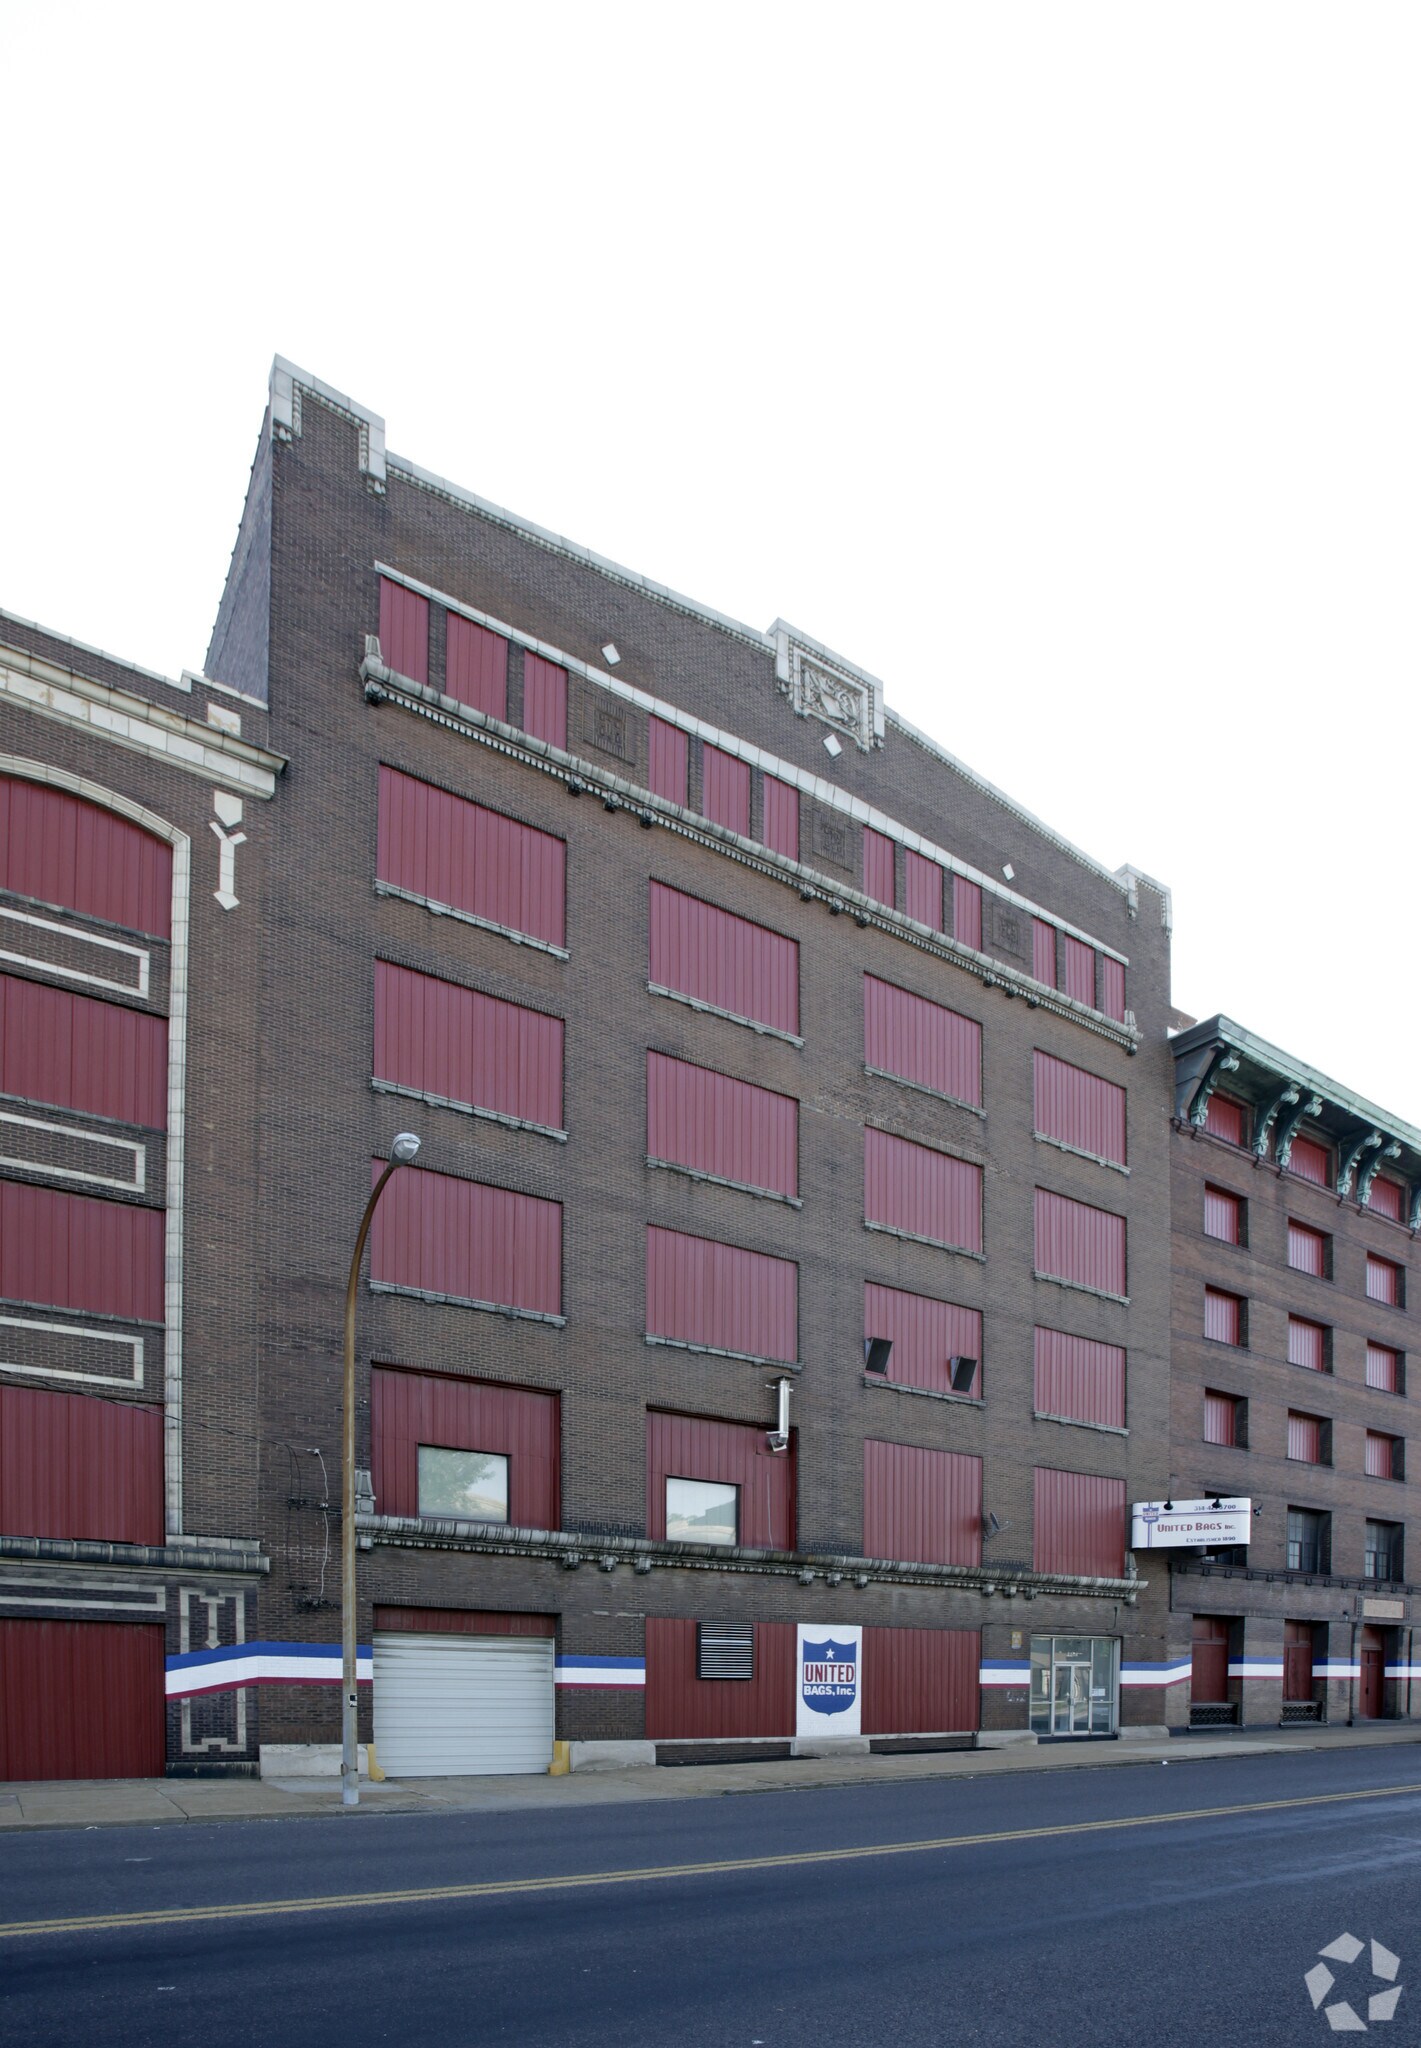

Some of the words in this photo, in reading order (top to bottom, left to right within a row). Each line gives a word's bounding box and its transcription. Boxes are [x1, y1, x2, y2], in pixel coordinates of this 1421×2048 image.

[1157, 1524, 1193, 1532] UNITED
[1195, 1522, 1222, 1531] BAGS
[805, 1664, 855, 1682] UNITED
[804, 1685, 836, 1696] BAGS,
[836, 1686, 855, 1696] Inc.
